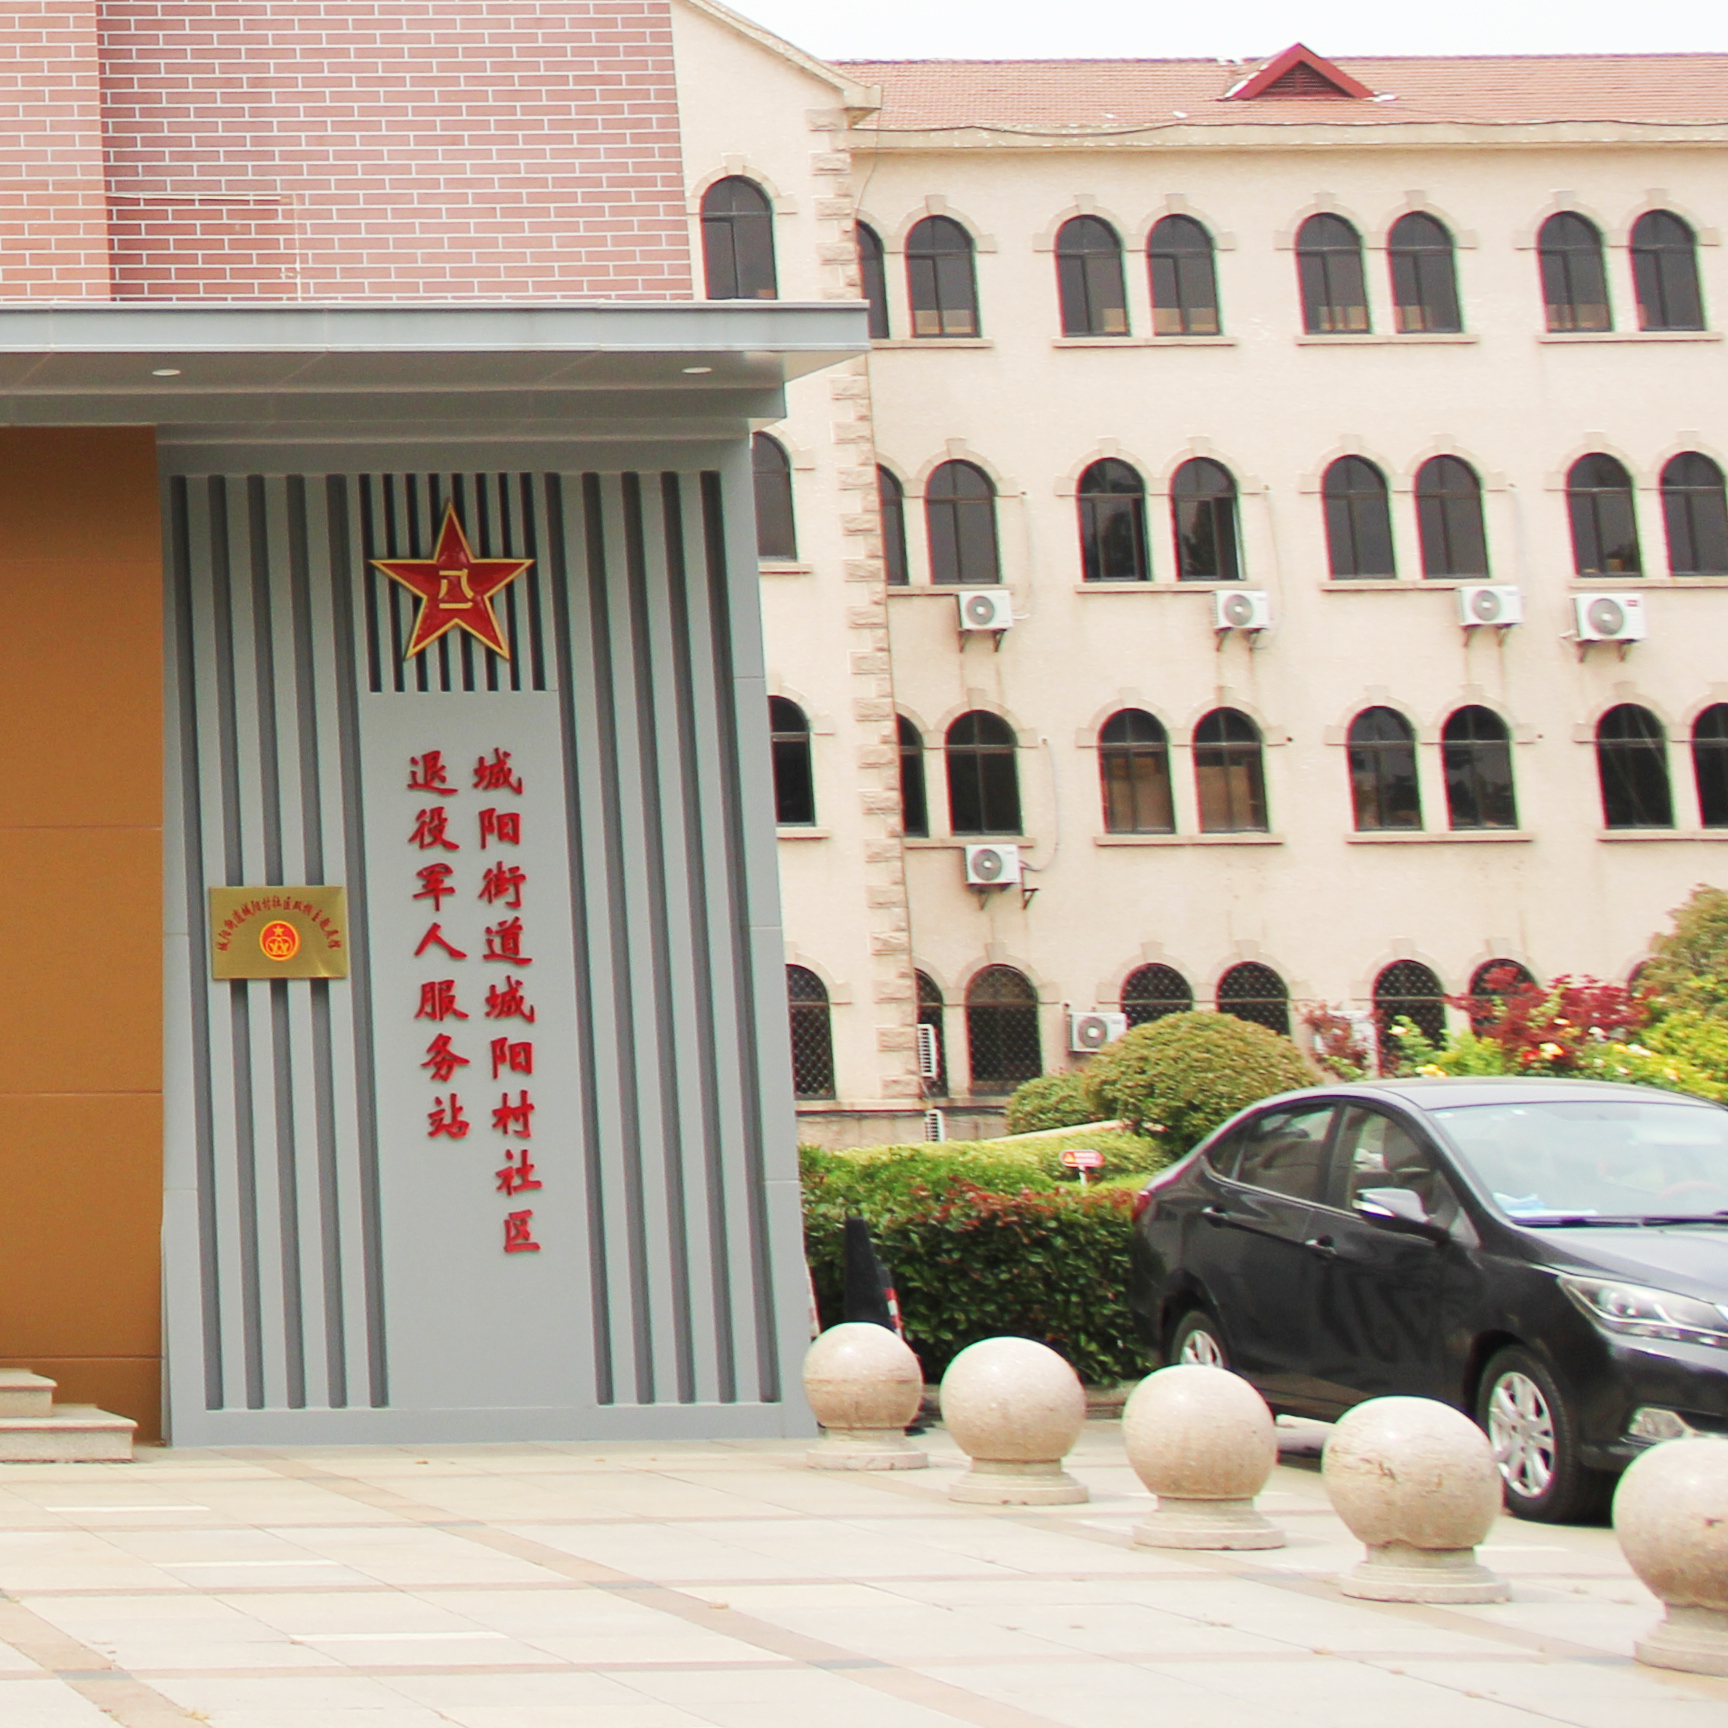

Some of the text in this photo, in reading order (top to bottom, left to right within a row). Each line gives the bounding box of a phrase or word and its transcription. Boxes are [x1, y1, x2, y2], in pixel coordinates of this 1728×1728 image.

[407, 751, 471, 1140] 退役军人服务站
[473, 748, 543, 1255] 城阳街道城阳村社区
